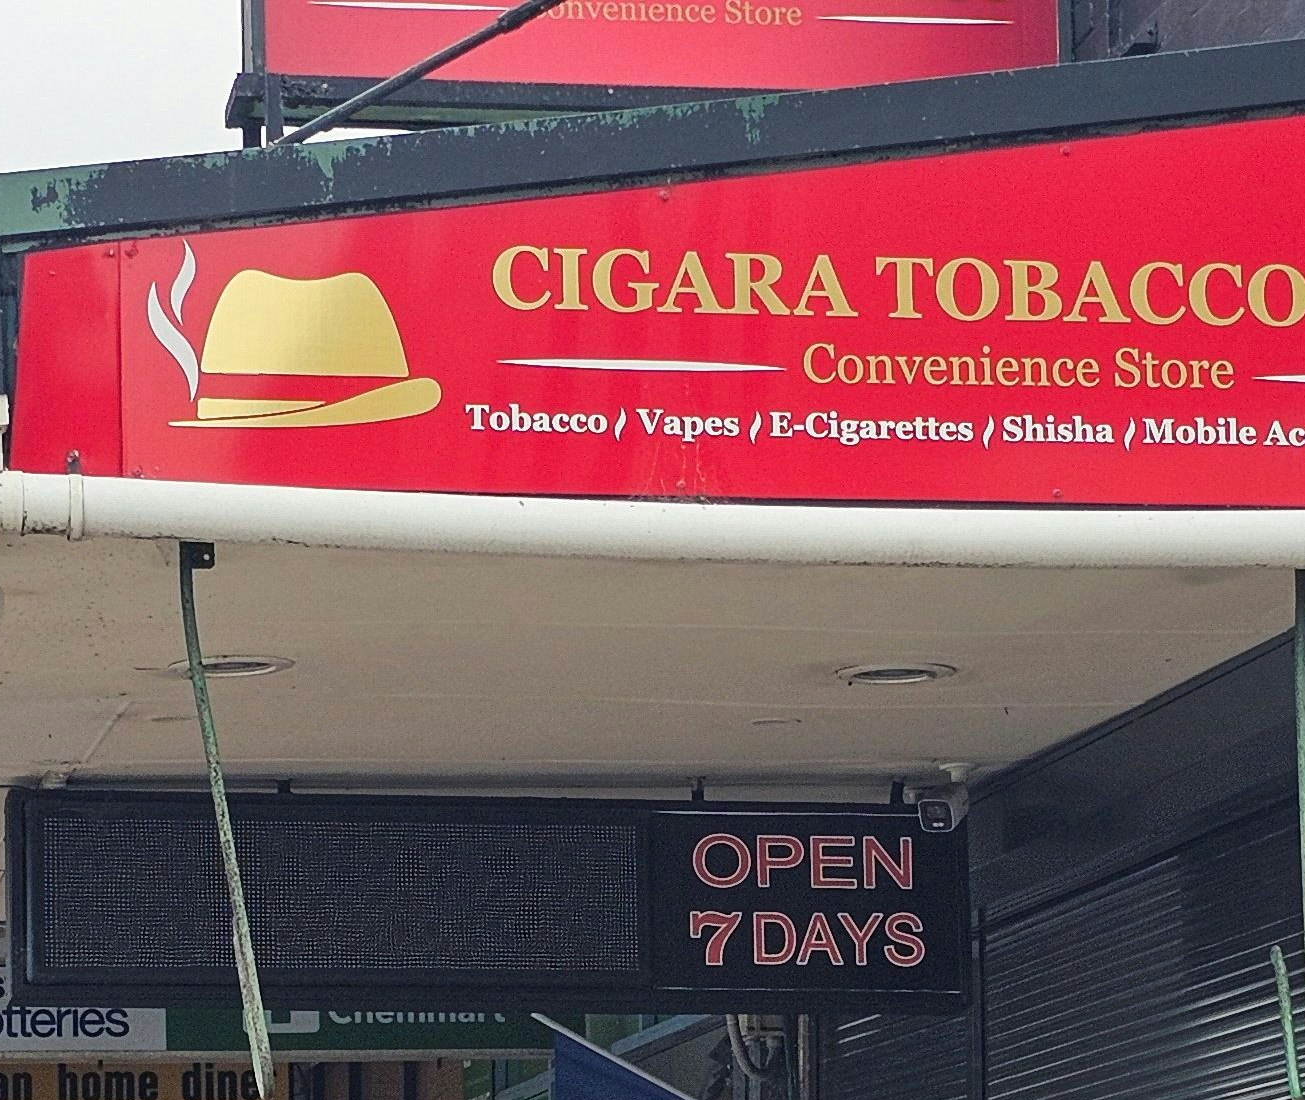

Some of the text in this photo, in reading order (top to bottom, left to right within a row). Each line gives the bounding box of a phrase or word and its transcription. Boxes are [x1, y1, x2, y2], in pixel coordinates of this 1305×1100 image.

[539, 0, 803, 27] onvenience Store
[491, 244, 859, 318] CIGARA
[802, 342, 1235, 390] Convenience Store
[464, 403, 608, 435] Tobacco
[636, 408, 740, 442] Vapes
[769, 411, 974, 444] E-Cigarettes
[1001, 415, 1115, 444] Shisha
[1142, 417, 1258, 447] Mobile
[692, 832, 914, 891] OPEN
[689, 910, 926, 968] 7 DAYS
